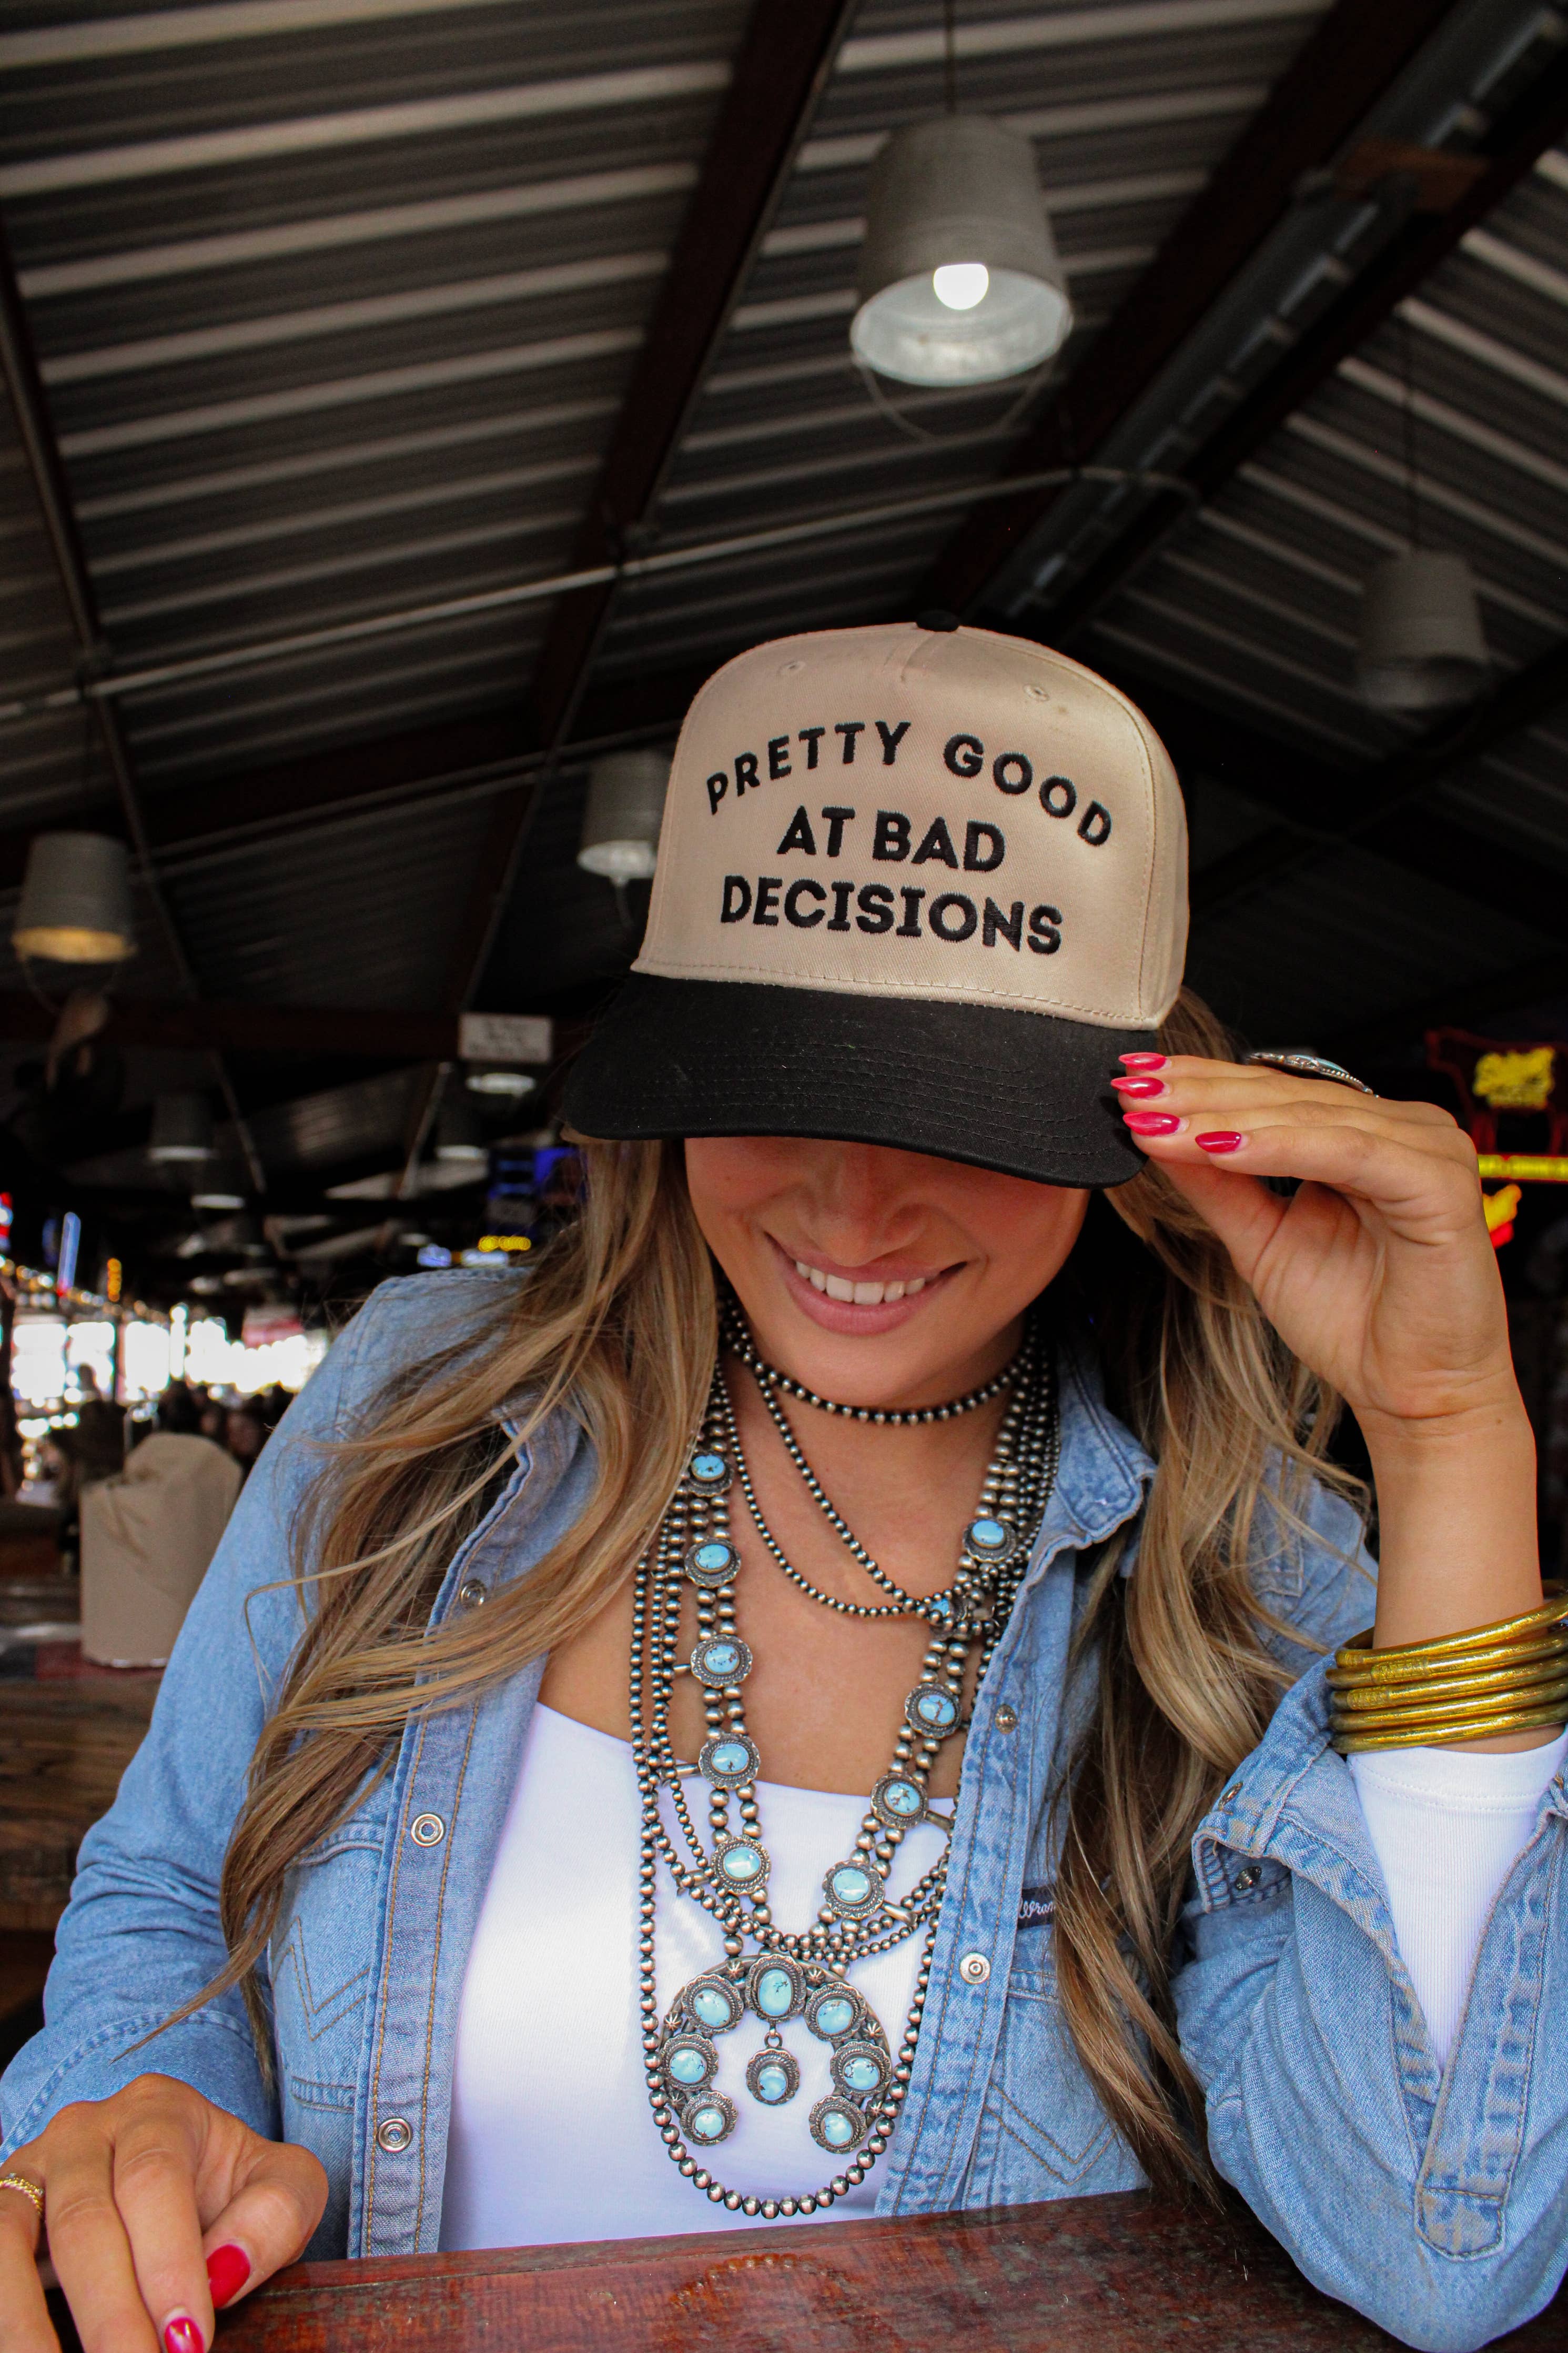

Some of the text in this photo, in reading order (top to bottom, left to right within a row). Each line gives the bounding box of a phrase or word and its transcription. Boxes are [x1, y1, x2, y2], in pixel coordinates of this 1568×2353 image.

[706, 720, 1112, 846] PRETTY GOOD
[776, 806, 1006, 873] AT BAD
[720, 874, 1064, 955] DECISIONS
